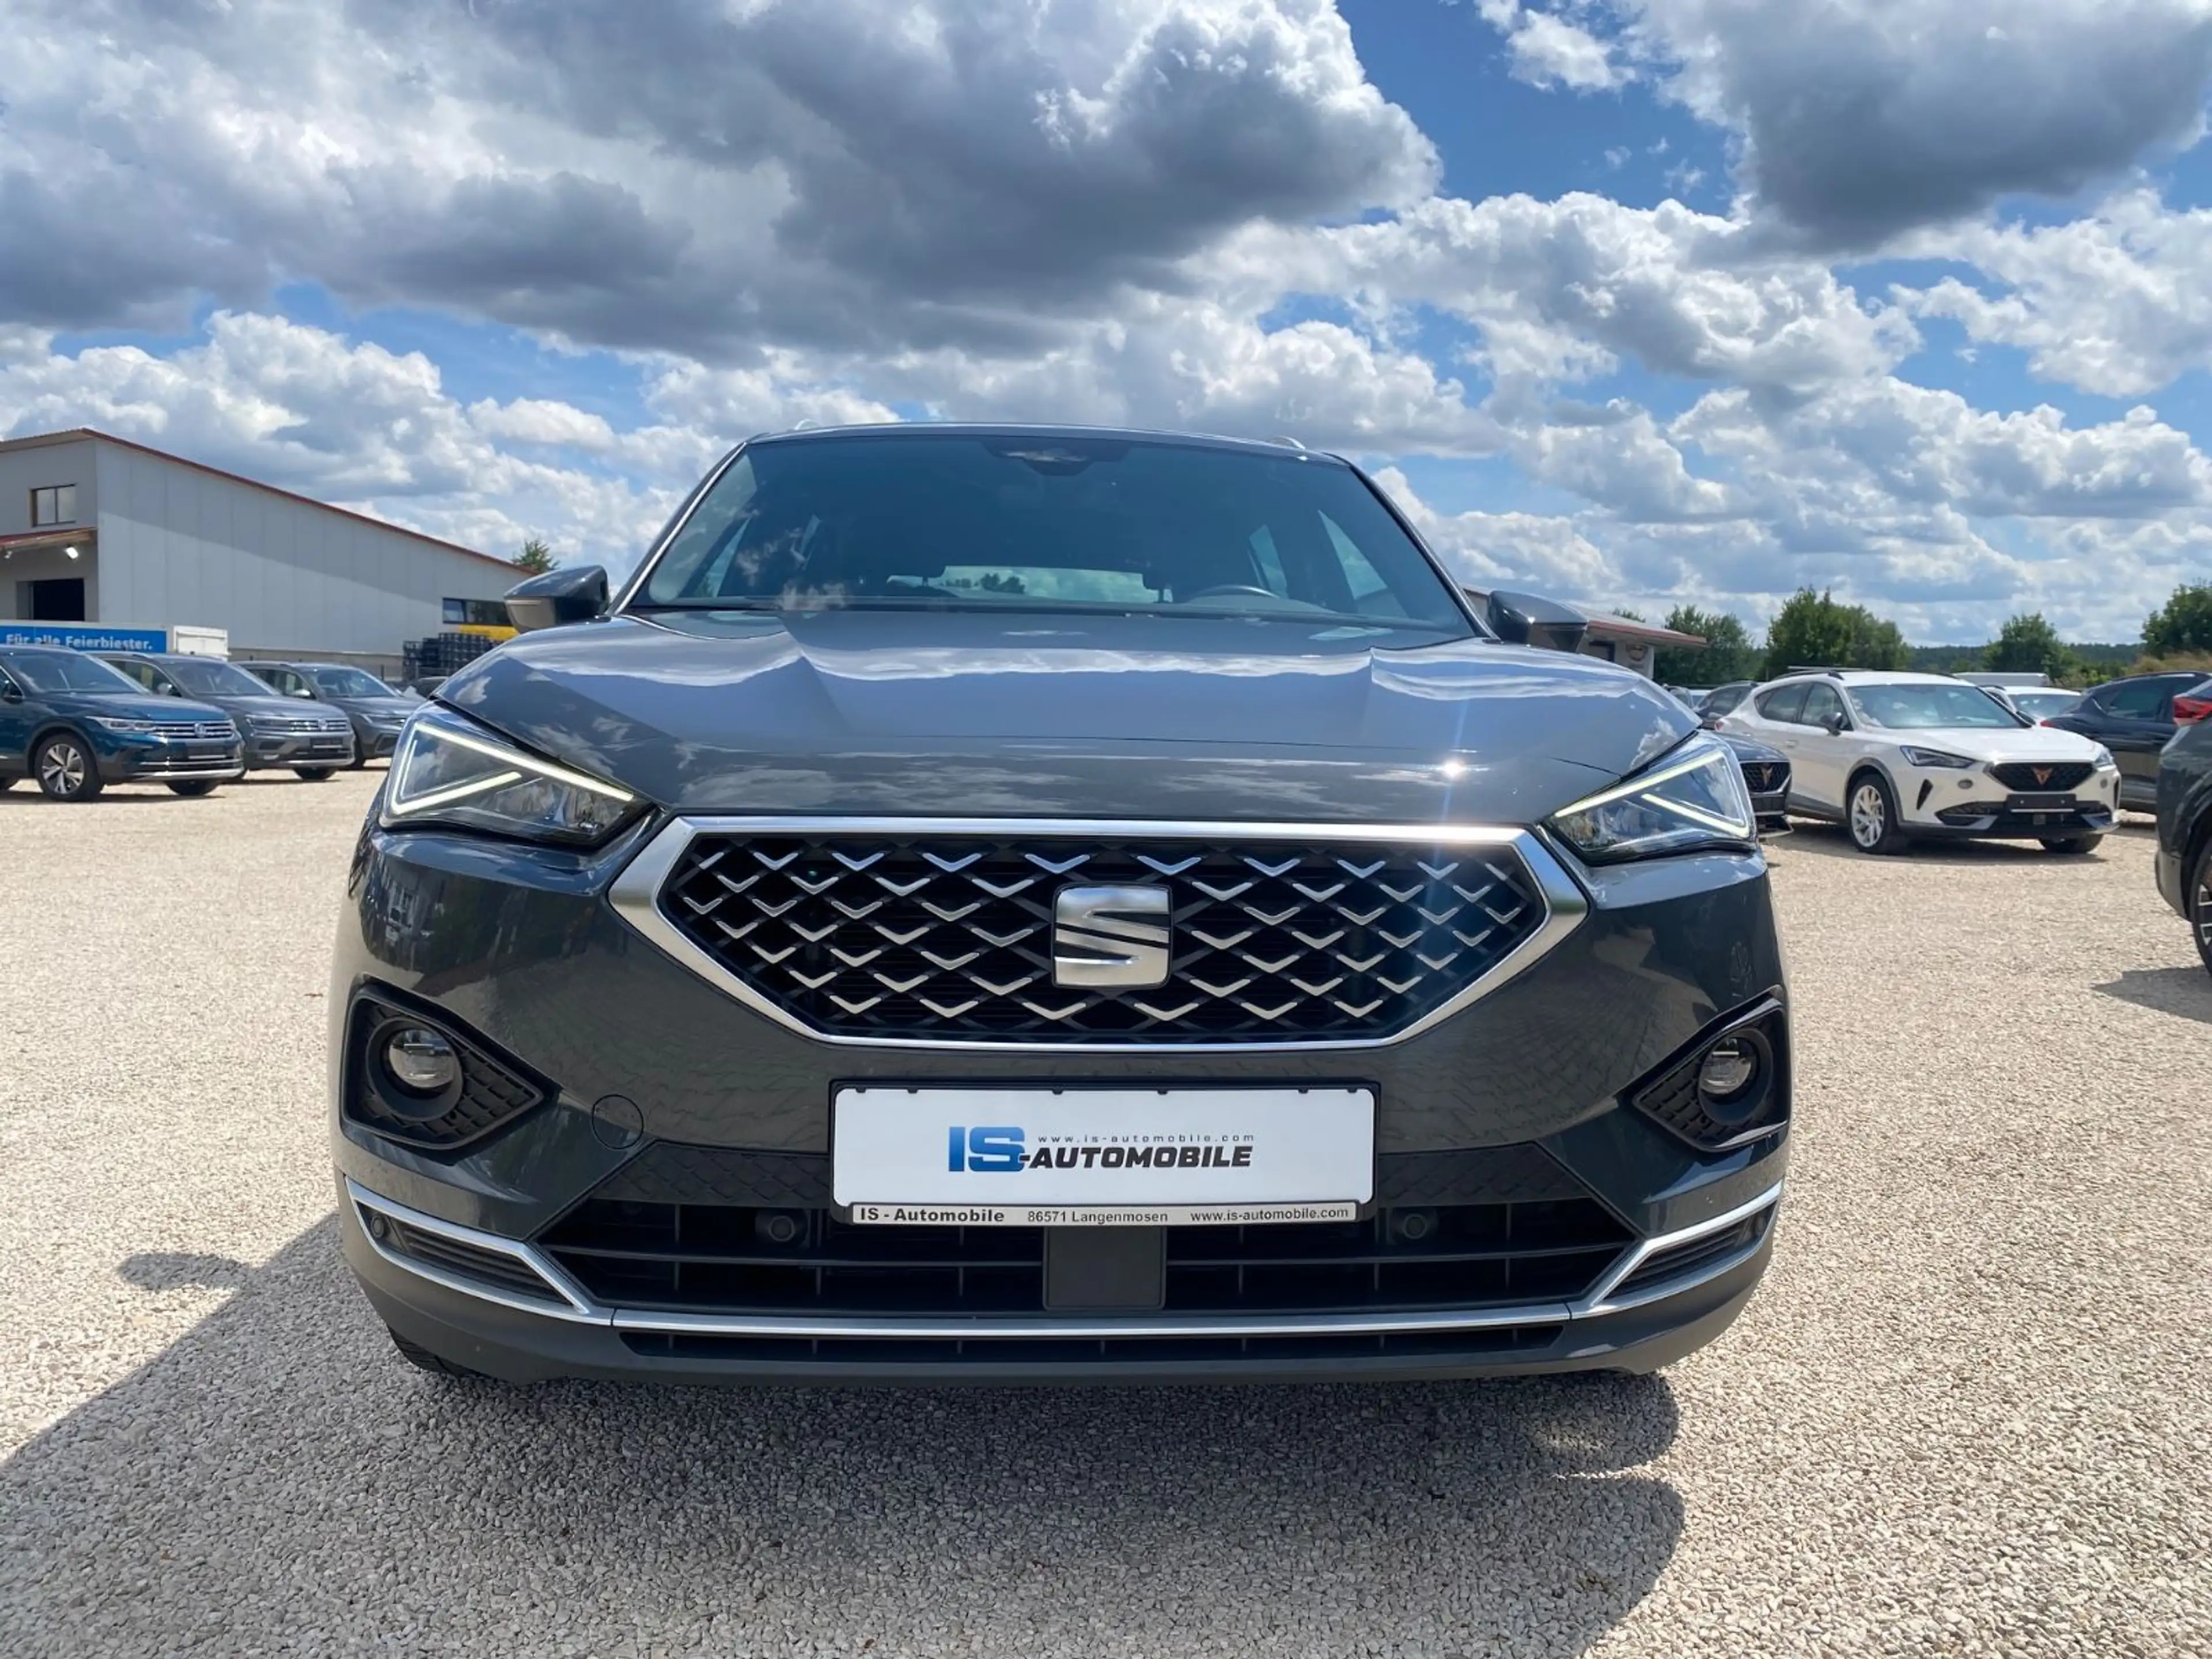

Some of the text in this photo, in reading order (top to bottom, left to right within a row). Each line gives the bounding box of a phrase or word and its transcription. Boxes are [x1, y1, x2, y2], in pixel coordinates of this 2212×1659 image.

[6, 632, 30, 645] Für
[66, 635, 153, 650] Feierbiester.
[1038, 1134, 1254, 1143] www.is-automobile.com
[861, 1207, 879, 1220] IS
[893, 1208, 1005, 1222] Automobile
[1028, 1211, 1066, 1223] 86571
[1071, 1211, 1168, 1225] Langenmosen
[1190, 1207, 1349, 1221] www.is-automobile.com
